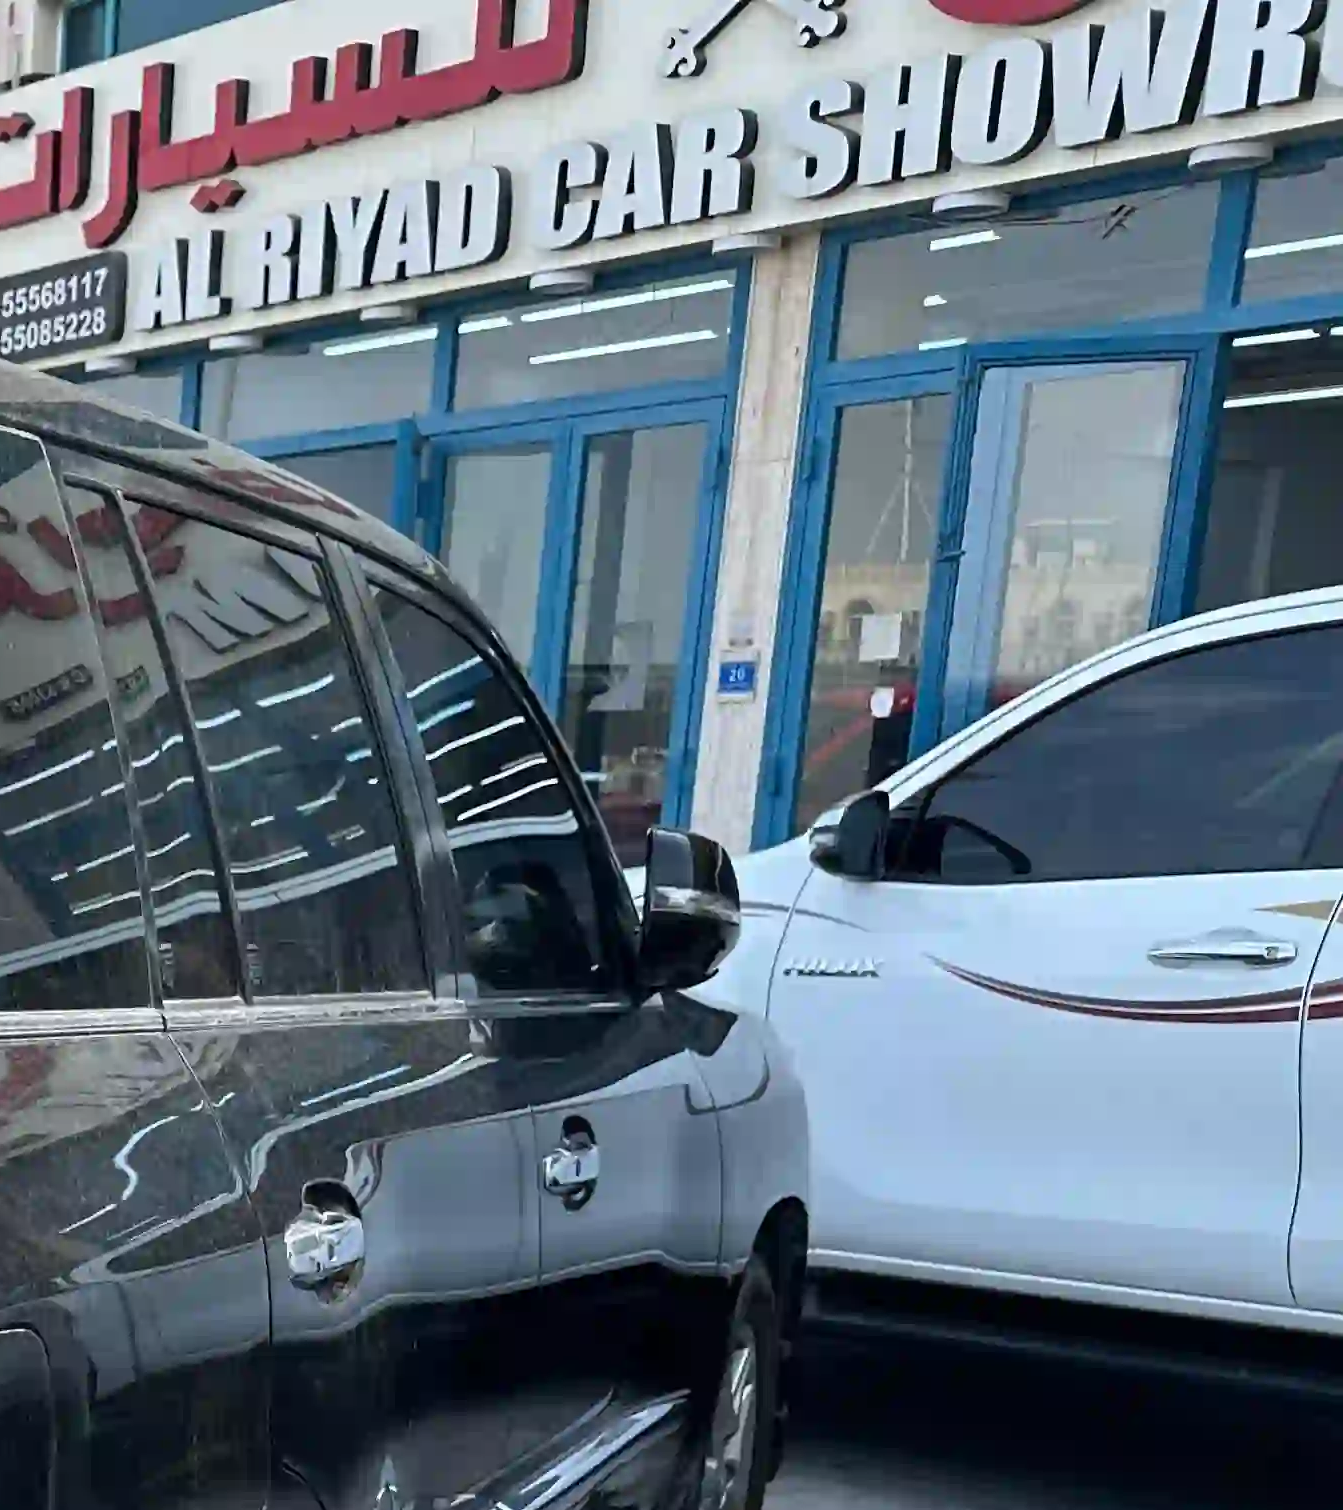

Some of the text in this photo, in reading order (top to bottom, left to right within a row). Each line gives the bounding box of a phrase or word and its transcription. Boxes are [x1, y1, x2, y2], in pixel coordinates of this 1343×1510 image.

[135, 0, 1343, 331] AL RIYAD CAR SHOWR
